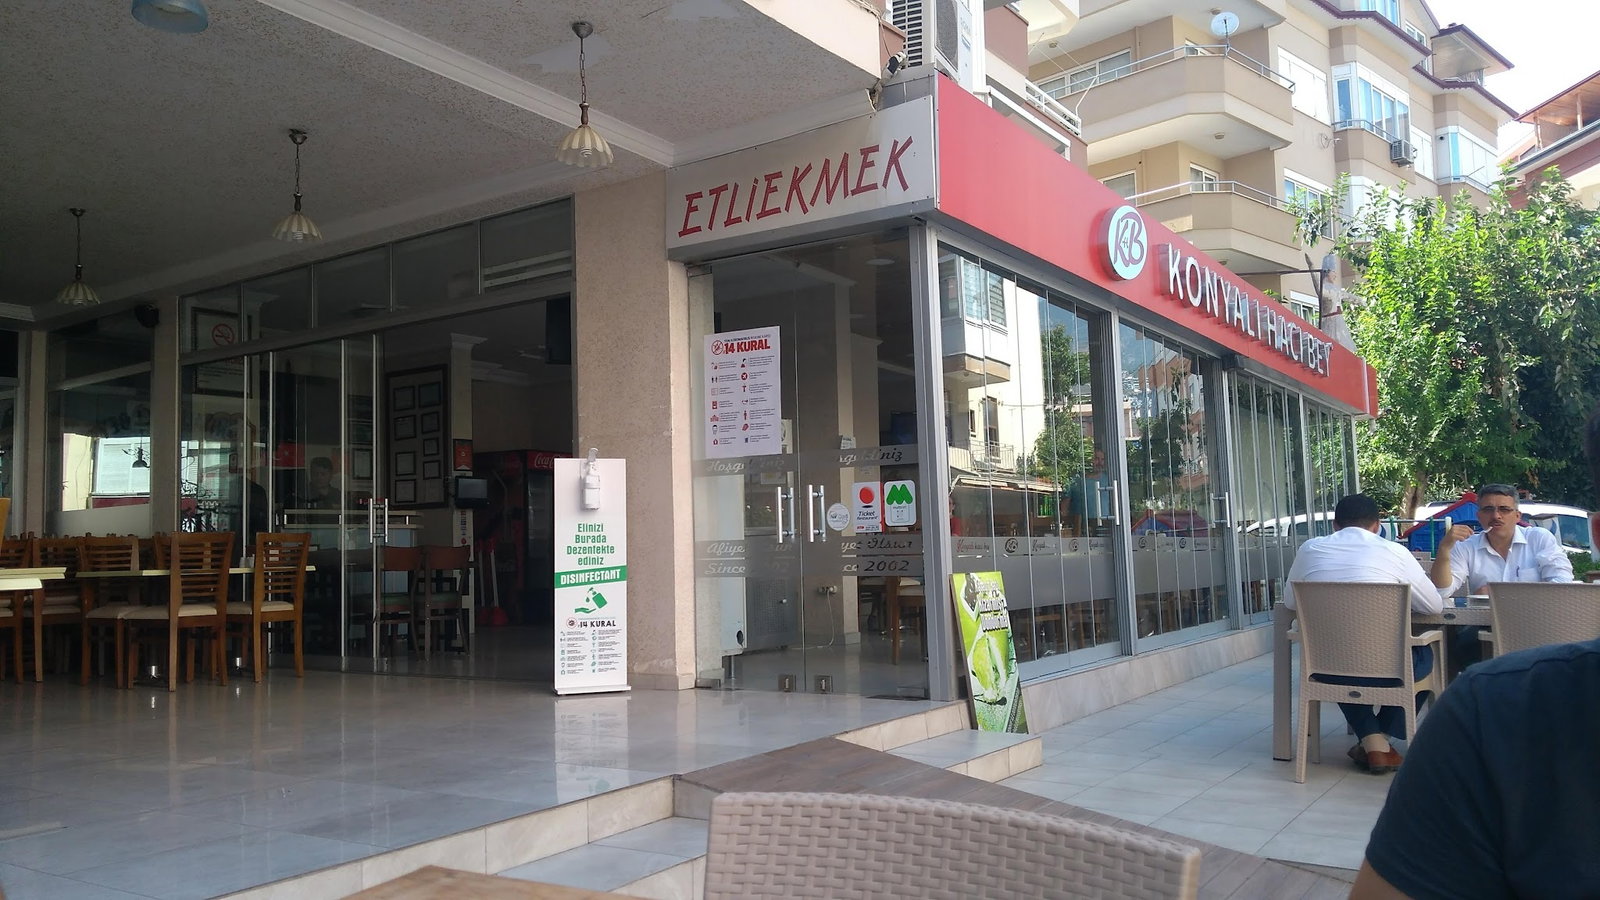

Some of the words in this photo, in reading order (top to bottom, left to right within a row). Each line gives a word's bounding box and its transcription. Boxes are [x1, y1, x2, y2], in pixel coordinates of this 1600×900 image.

[1166, 242, 1262, 341] KONYALI
[1307, 337, 1334, 377] BEY
[724, 342, 735, 354] 14
[737, 338, 771, 352] KURAL
[577, 523, 604, 532] Elinizi
[575, 534, 607, 543] Burada
[577, 556, 604, 565] ediniz
[863, 560, 910, 572] 2002
[705, 562, 746, 574] Since
[560, 568, 621, 585] DISINFECTANT
